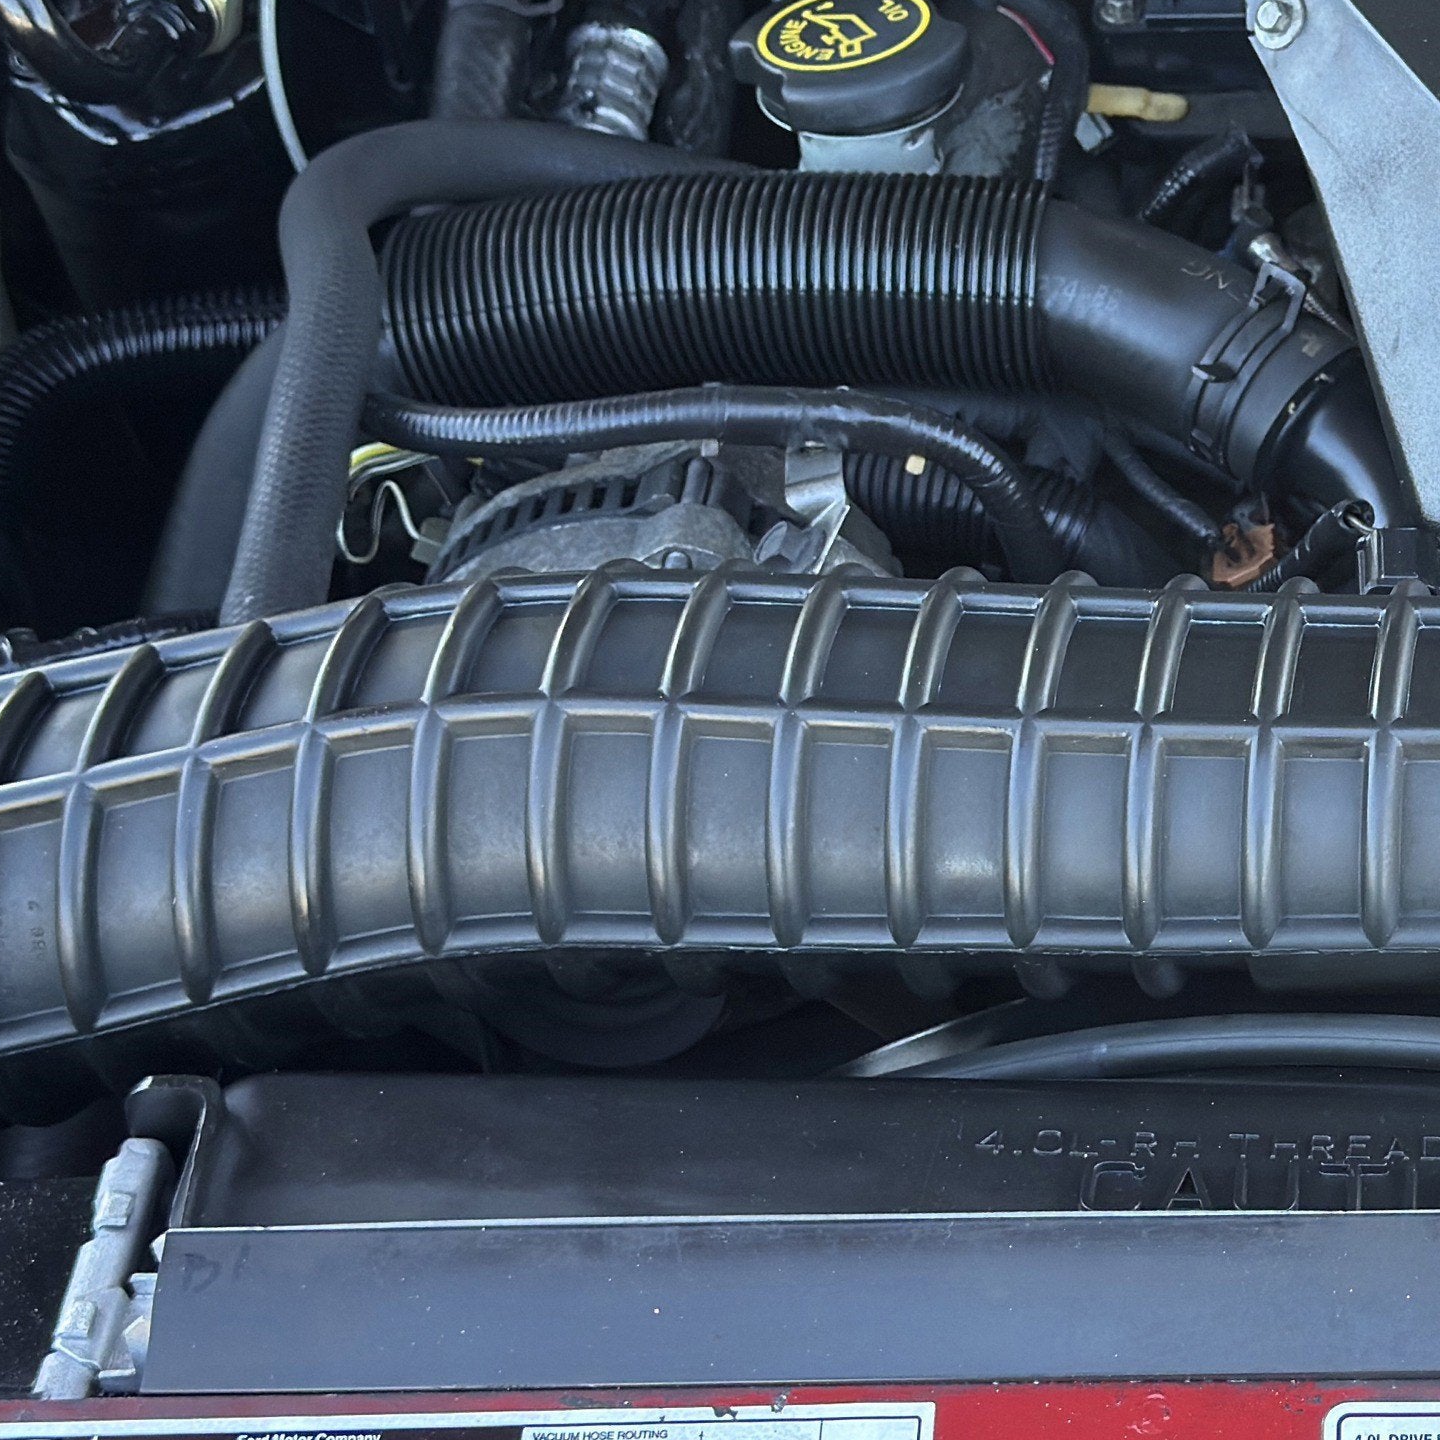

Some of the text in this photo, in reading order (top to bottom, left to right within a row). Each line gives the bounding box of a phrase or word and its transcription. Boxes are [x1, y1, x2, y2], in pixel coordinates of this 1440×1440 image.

[780, 19, 835, 61] ENGINE
[532, 1429, 667, 1440] VACUUM HOSE ROUTING
